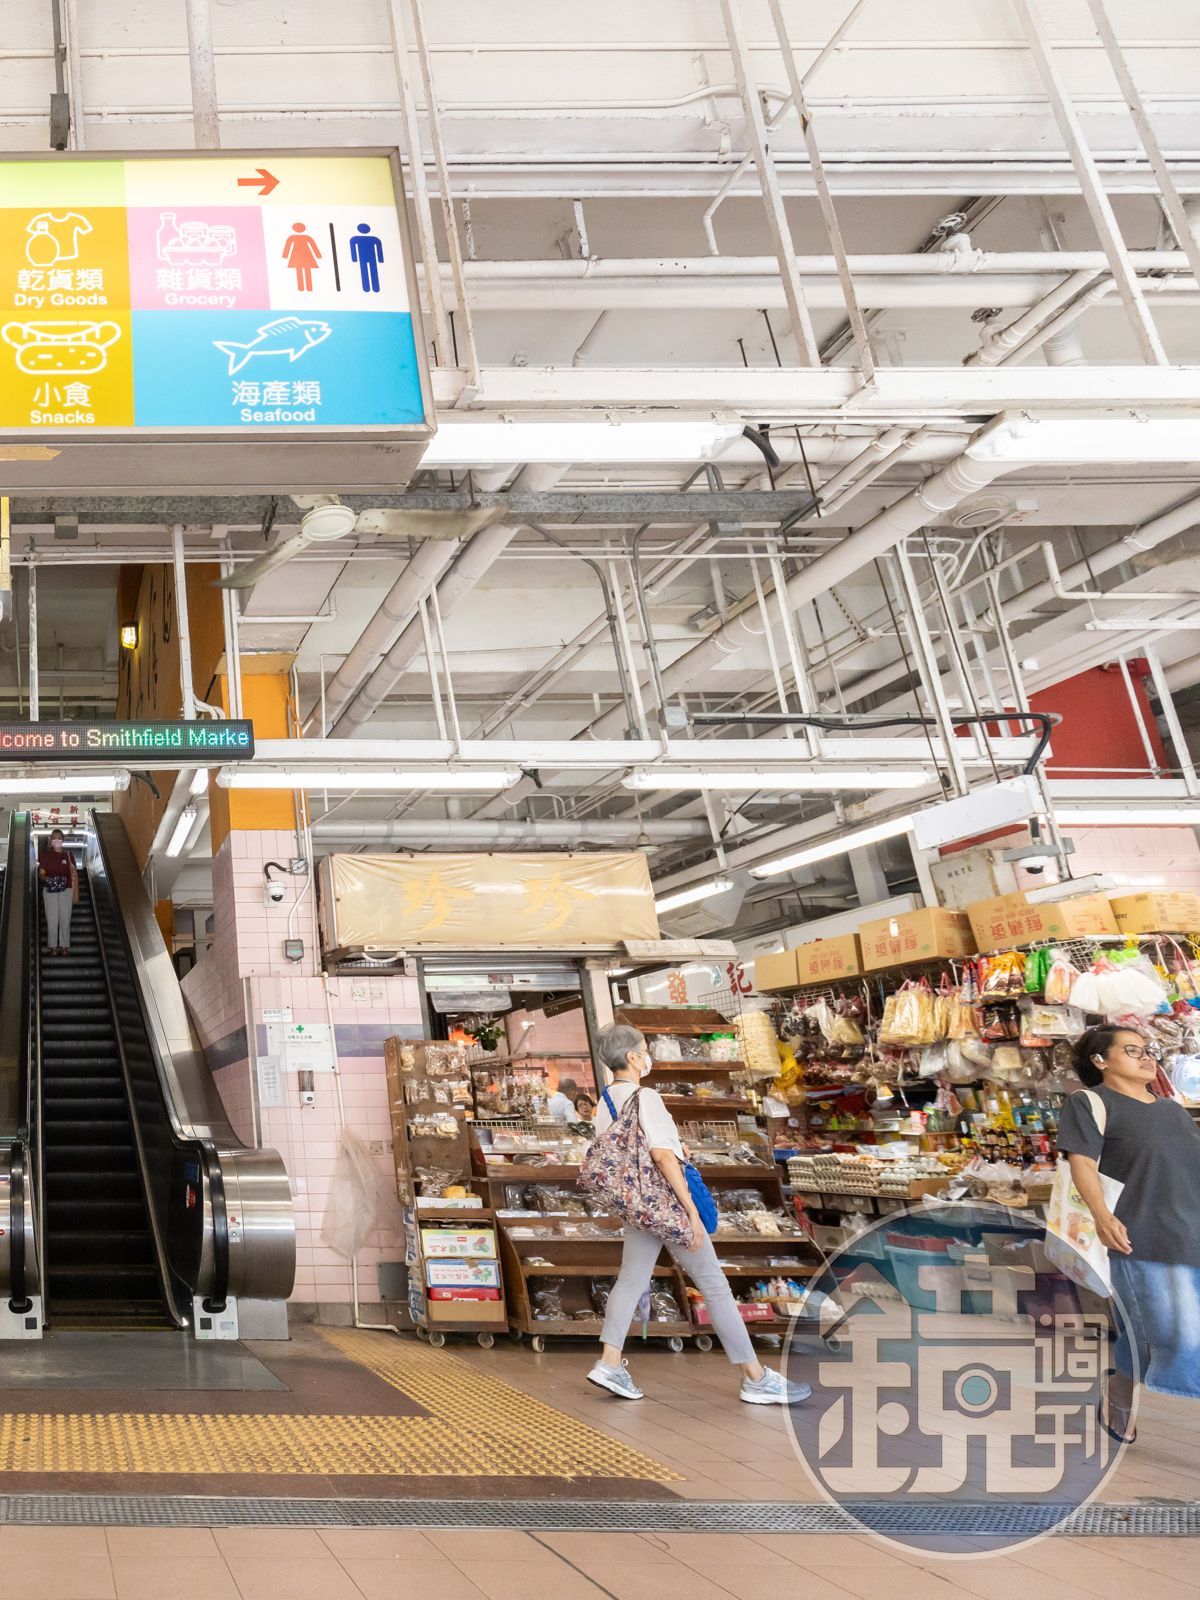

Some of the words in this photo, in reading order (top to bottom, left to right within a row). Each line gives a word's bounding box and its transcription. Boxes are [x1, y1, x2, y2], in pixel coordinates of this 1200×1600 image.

[17, 268, 104, 292] 乾貨類
[156, 268, 242, 292] 雜貨類
[14, 294, 44, 309] Dry
[50, 292, 108, 306] Goods
[165, 293, 236, 308] Grocery
[33, 381, 92, 408] 小食
[232, 380, 322, 407] 海產類
[29, 410, 95, 424] Snacks
[241, 408, 316, 422] Seafood
[62, 730, 80, 747] to
[87, 728, 182, 747] Smithfield
[188, 728, 249, 746] Marke
